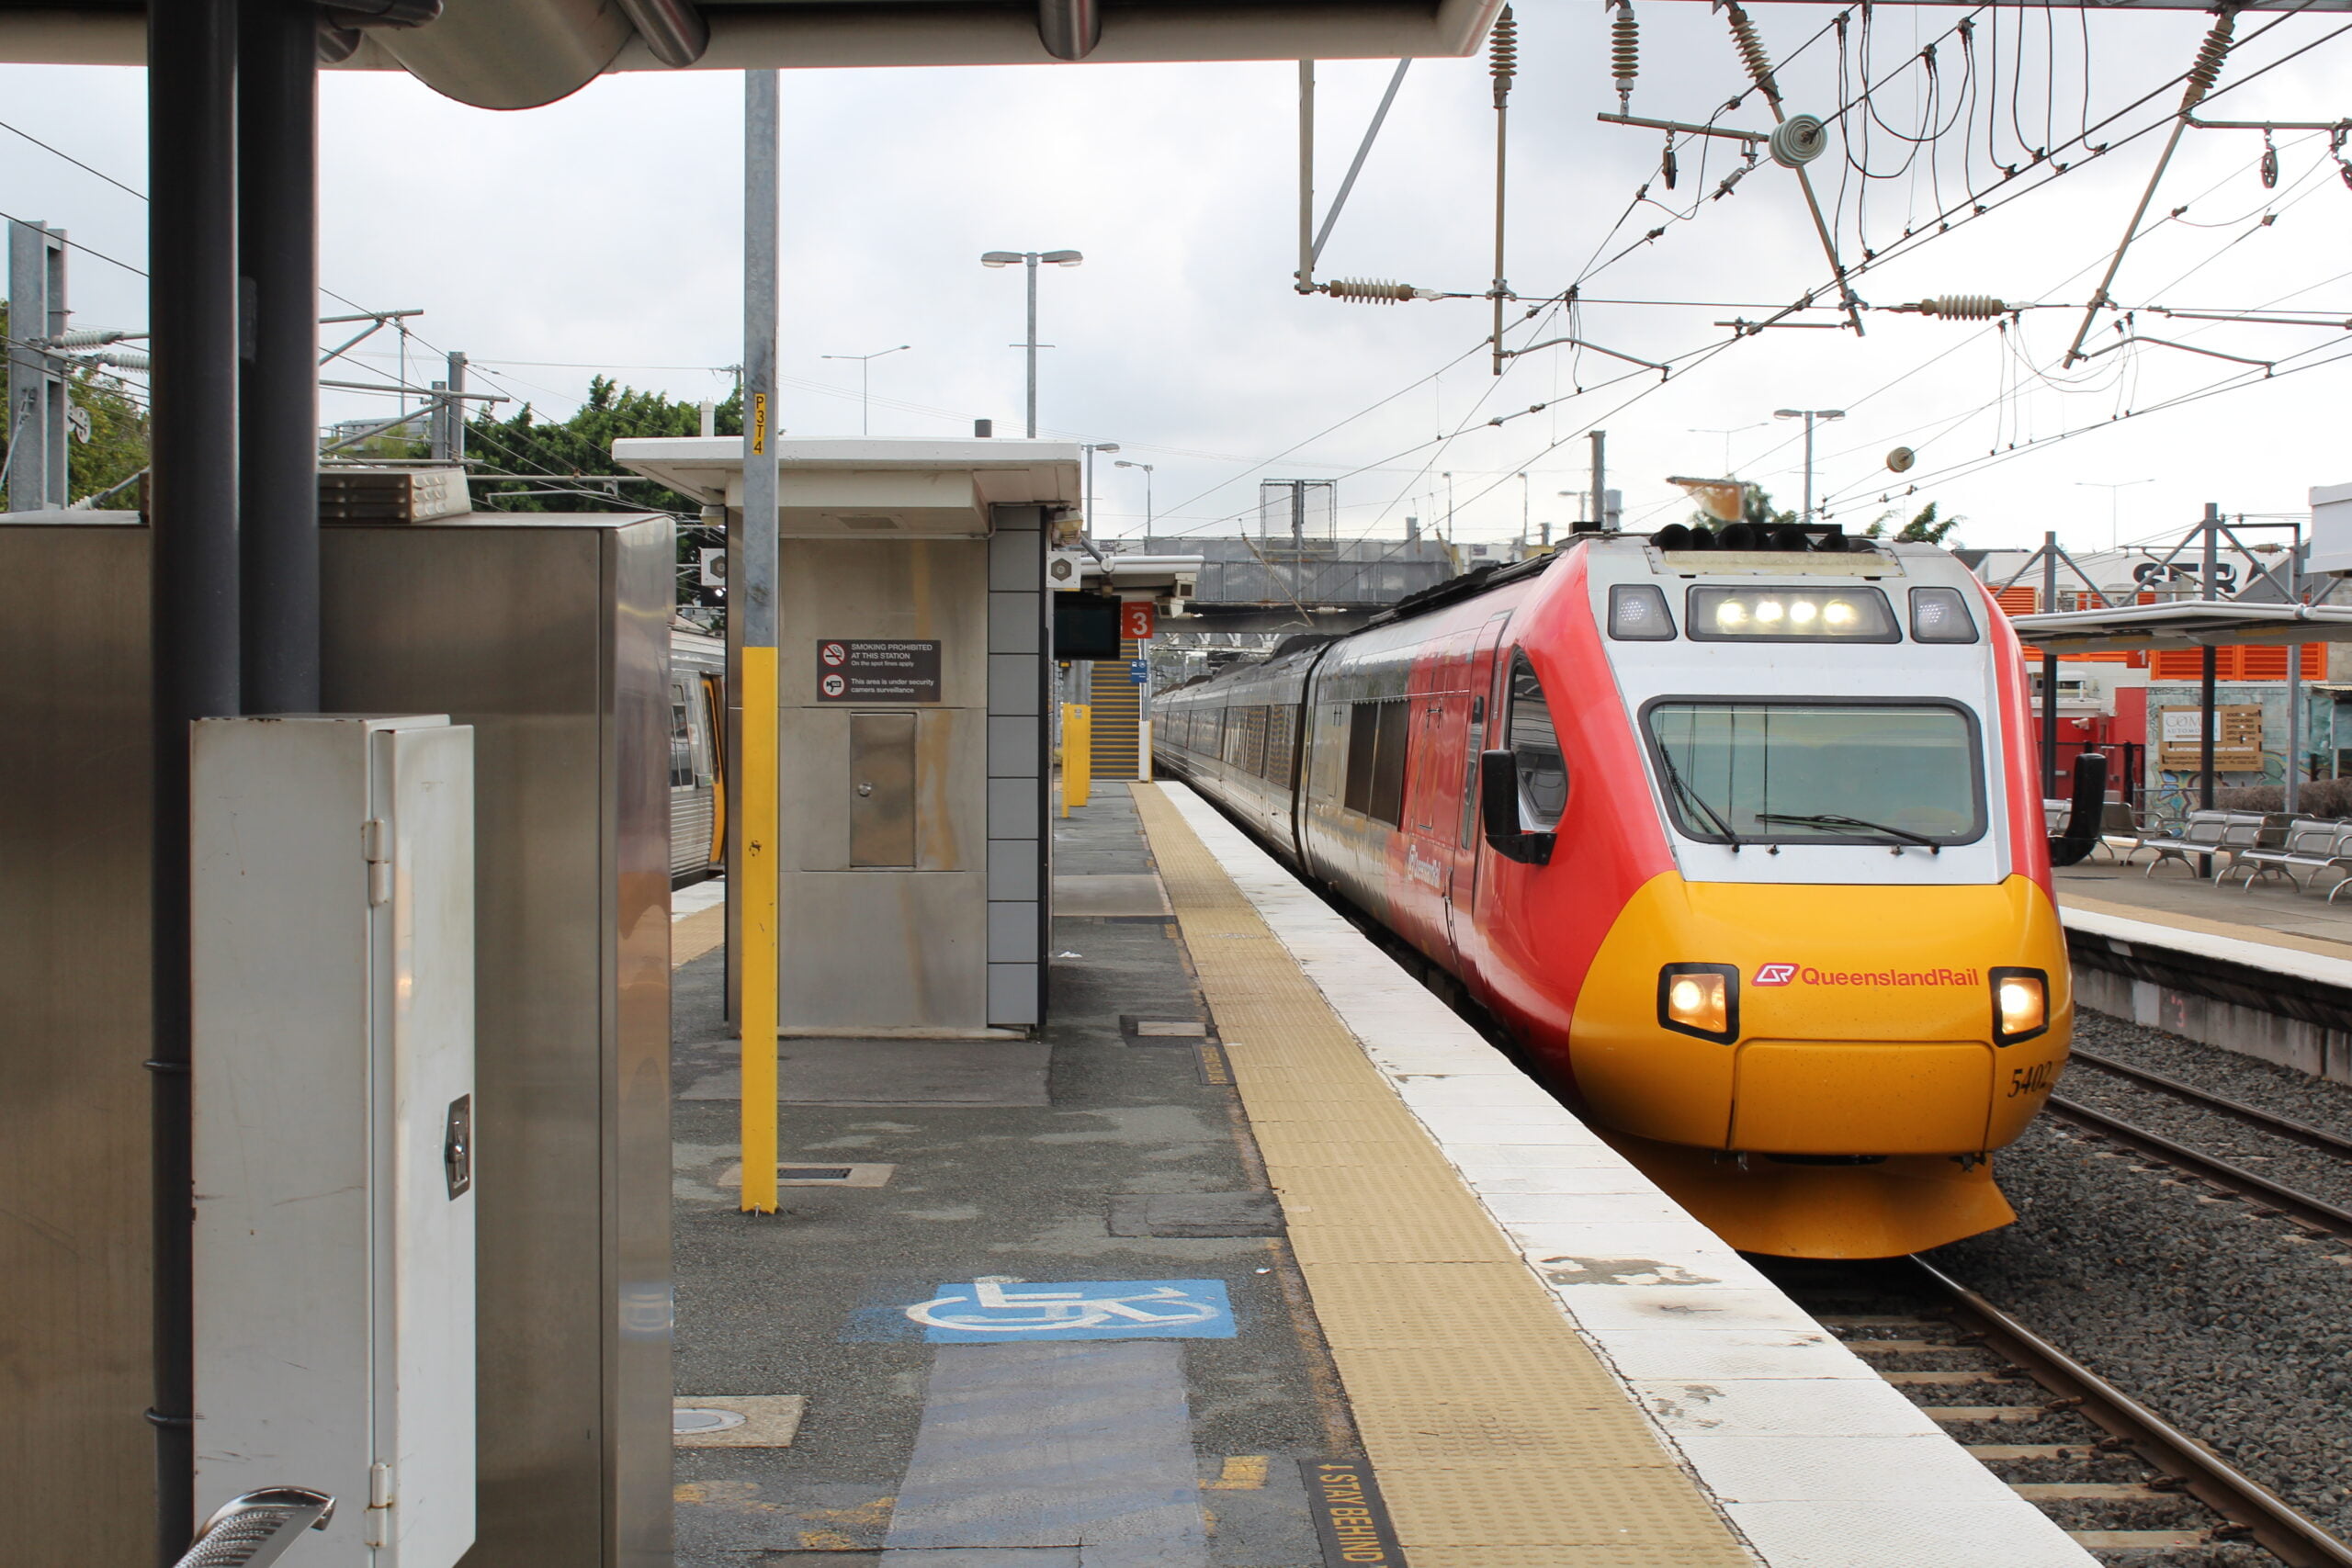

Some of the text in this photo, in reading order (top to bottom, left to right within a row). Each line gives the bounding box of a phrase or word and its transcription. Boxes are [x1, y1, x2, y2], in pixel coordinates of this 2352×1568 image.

[753, 396, 764, 454] P3T4
[1132, 612, 1148, 635] 3
[2137, 649, 2146, 665] 1
[909, 678, 934, 686] security
[1802, 967, 1979, 987] QueenslandRail
[2007, 1061, 2053, 1098] 5402
[1319, 1474, 1367, 1506] STAY
[1330, 1507, 1385, 1562] BEHIND
